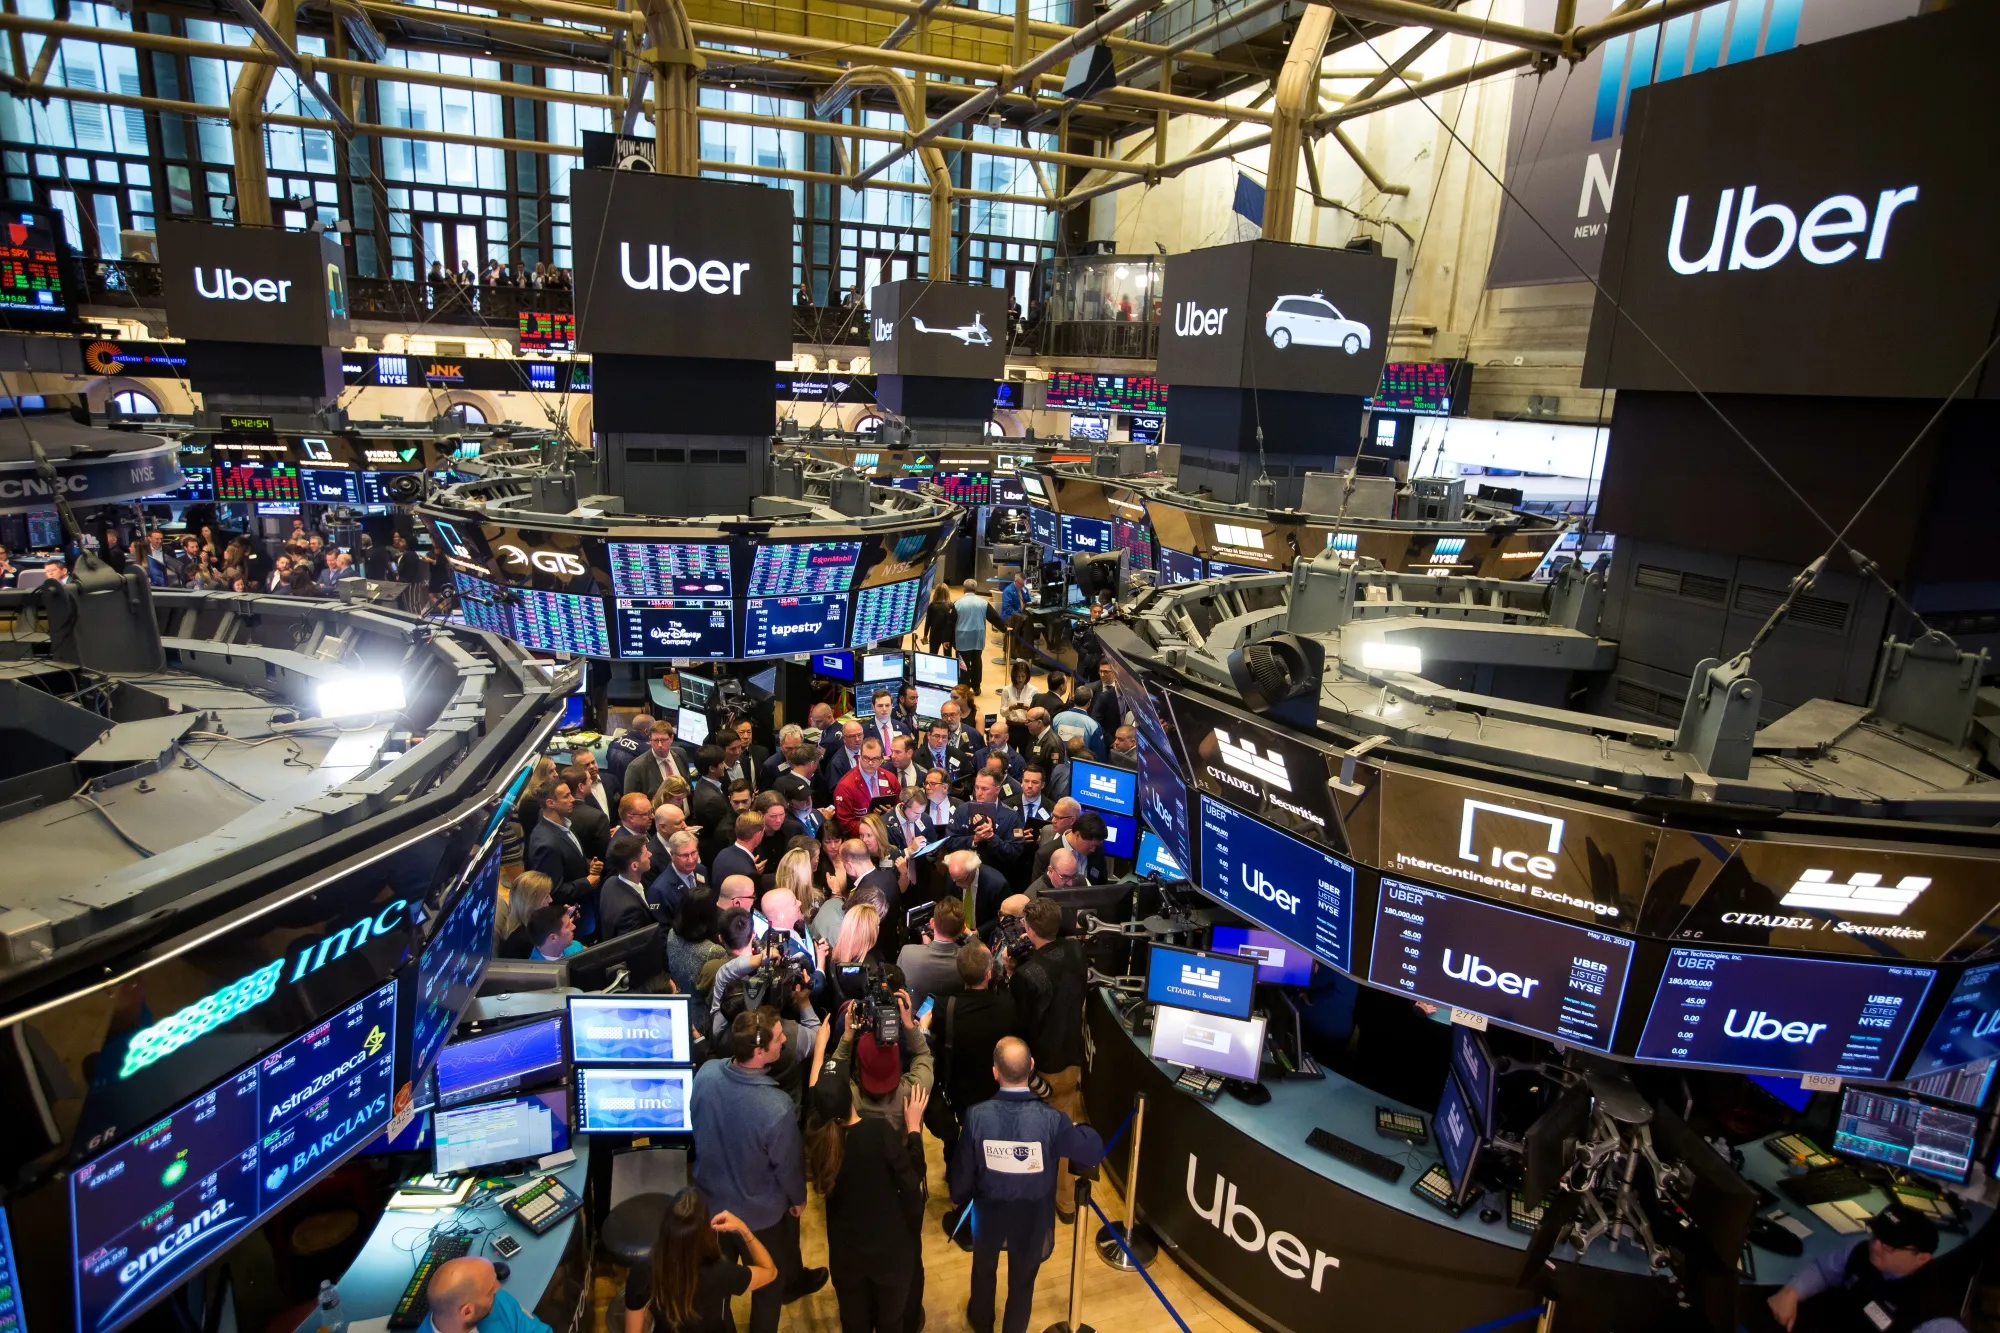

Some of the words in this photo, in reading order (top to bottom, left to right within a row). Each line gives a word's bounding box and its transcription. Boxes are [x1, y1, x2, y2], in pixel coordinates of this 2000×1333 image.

[1574, 223, 1601, 238] NEW
[1668, 184, 1919, 275] Uber
[621, 242, 750, 295] Uber
[194, 266, 292, 303] Uber
[1175, 302, 1228, 337] Uber
[875, 318, 893, 342] Uber
[112, 355, 143, 363] cuttone
[151, 357, 187, 365] company
[426, 364, 462, 376] JNK
[380, 376, 408, 385] NYSE
[532, 380, 555, 389] NYSE
[231, 419, 269, 428] 9:42:54
[1143, 420, 1159, 429] GTS
[131, 466, 155, 484] NYSE
[0, 475, 88, 498] CNBC
[319, 485, 342, 495] Uber
[1004, 491, 1024, 500] Uber
[1038, 525, 1050, 537] Uber
[1075, 534, 1097, 547] Uber
[531, 551, 586, 575] GTS
[812, 555, 853, 564] ExxonMobil
[1430, 555, 1459, 564] NYSE
[882, 561, 912, 576] NYSE
[771, 622, 822, 637] tapestry
[620, 738, 639, 750] GTS
[1080, 789, 1101, 799] CITADEL
[1105, 795, 1125, 805] Securities
[1206, 765, 1260, 797] CITADEL
[1269, 793, 1326, 827] Securities
[1152, 787, 1173, 831] Uber
[1205, 804, 1227, 822] UBER
[1145, 862, 1165, 874] CITADEL
[1242, 862, 1300, 915] Uber
[1318, 879, 1341, 896] UBER
[1383, 879, 1397, 888] Uber
[1398, 882, 1435, 897] Technologies,
[1436, 892, 1446, 900] Inc.
[1397, 853, 1526, 893] Intercontinental
[1531, 886, 1619, 917] Exchange
[1318, 891, 1340, 906] LISTED
[1389, 888, 1423, 906] UBER
[1318, 900, 1340, 917] NYSE
[1384, 906, 1424, 922] 180,000,000
[1721, 911, 1813, 931] CITADEL
[1833, 920, 1927, 940] Securities
[1403, 929, 1422, 940] 45.00
[1587, 932, 1601, 941] May
[1602, 934, 1612, 943] 10,
[1613, 937, 1630, 947] 2019
[1404, 946, 1419, 956] 0.00
[1690, 950, 1730, 961] Technologies,
[1402, 963, 1417, 972] 0.00
[1573, 956, 1608, 973] UBER
[1677, 957, 1716, 970] UBER
[1442, 948, 1539, 999] Uber
[1571, 969, 1605, 983] LISTED
[1889, 967, 1902, 975] May
[1914, 969, 1931, 977] 2019
[1400, 978, 1414, 987] 0.00
[1569, 980, 1602, 995] NYSE
[1668, 977, 1713, 987] 180,000,000
[1166, 985, 1196, 997] CITADEL
[1202, 992, 1231, 1003] Securities
[1685, 997, 1706, 1005] 45.00
[1868, 994, 1903, 1006] UBER
[1455, 1010, 1483, 1024] 2778
[1562, 1005, 1581, 1014] Goldman
[1862, 1007, 1897, 1016] LISTED
[1683, 1014, 1700, 1022] 0.00
[1858, 1017, 1892, 1028] NYSE
[1723, 1009, 1827, 1044] Uber
[1677, 1031, 1693, 1039] 0.00
[263, 1052, 282, 1069] AZN
[268, 1050, 366, 1123] AstraZeneca
[1808, 1075, 1836, 1085] 1808
[391, 1107, 411, 1132] 2425
[264, 1130, 281, 1147] BCS
[292, 1093, 386, 1174] BARCLAYS
[986, 1145, 1036, 1156] BAYCREST
[79, 1164, 96, 1180] BP
[1186, 1152, 1340, 1293] Uber
[119, 1198, 227, 1283] encana
[83, 1247, 108, 1269] ECA
